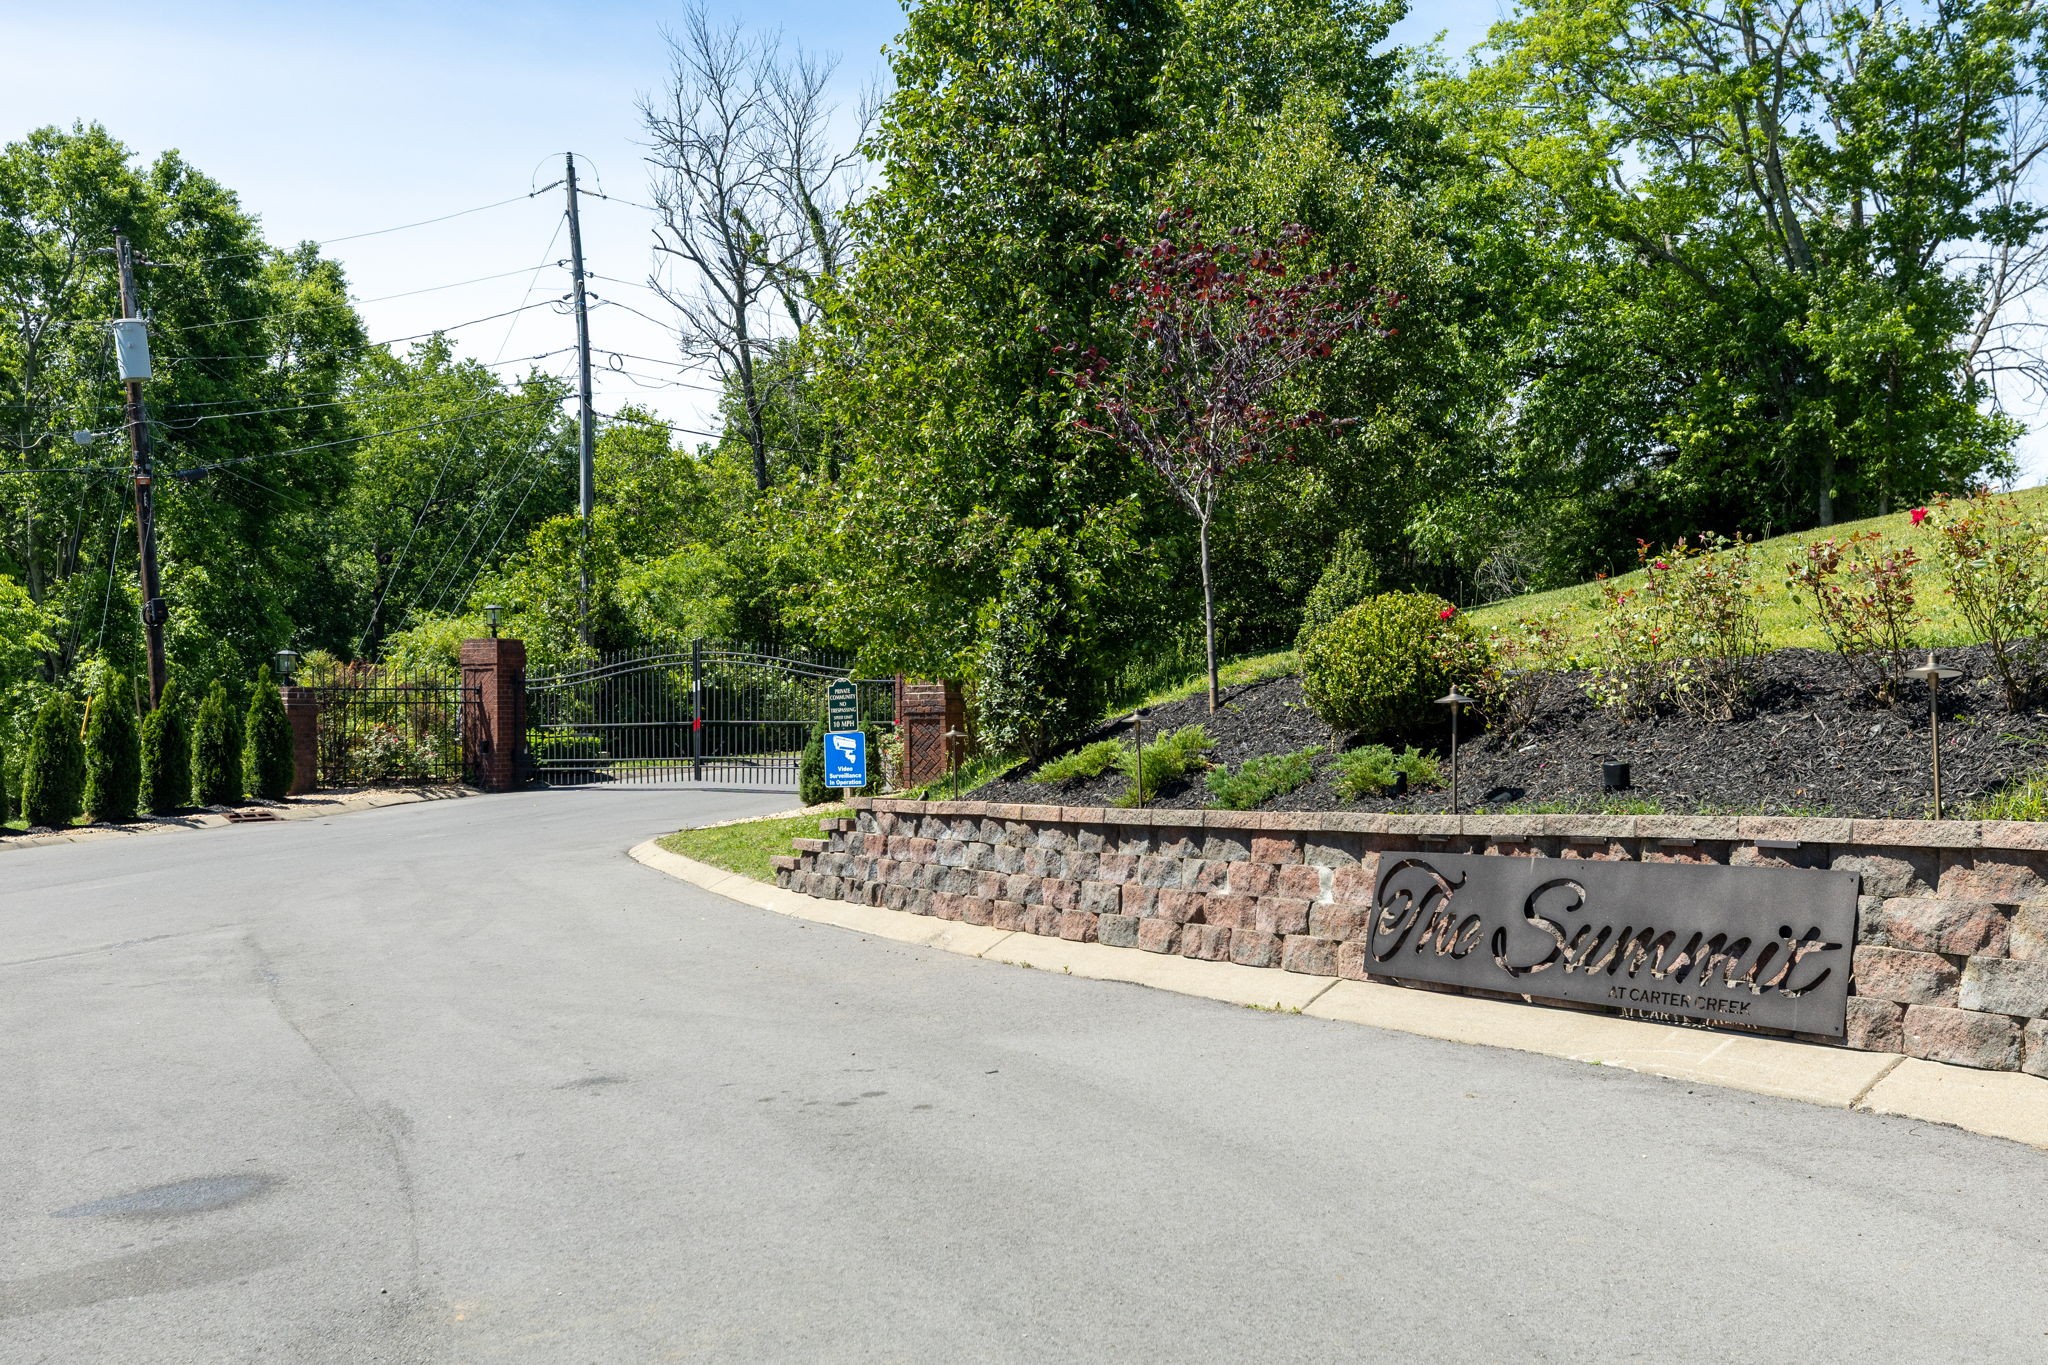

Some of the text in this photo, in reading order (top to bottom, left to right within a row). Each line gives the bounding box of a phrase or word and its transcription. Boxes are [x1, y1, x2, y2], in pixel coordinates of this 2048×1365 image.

[836, 779, 862, 787] Operation
[1371, 858, 1843, 999] The Summit
[1607, 986, 1752, 1016] AT CARTER CREEK
